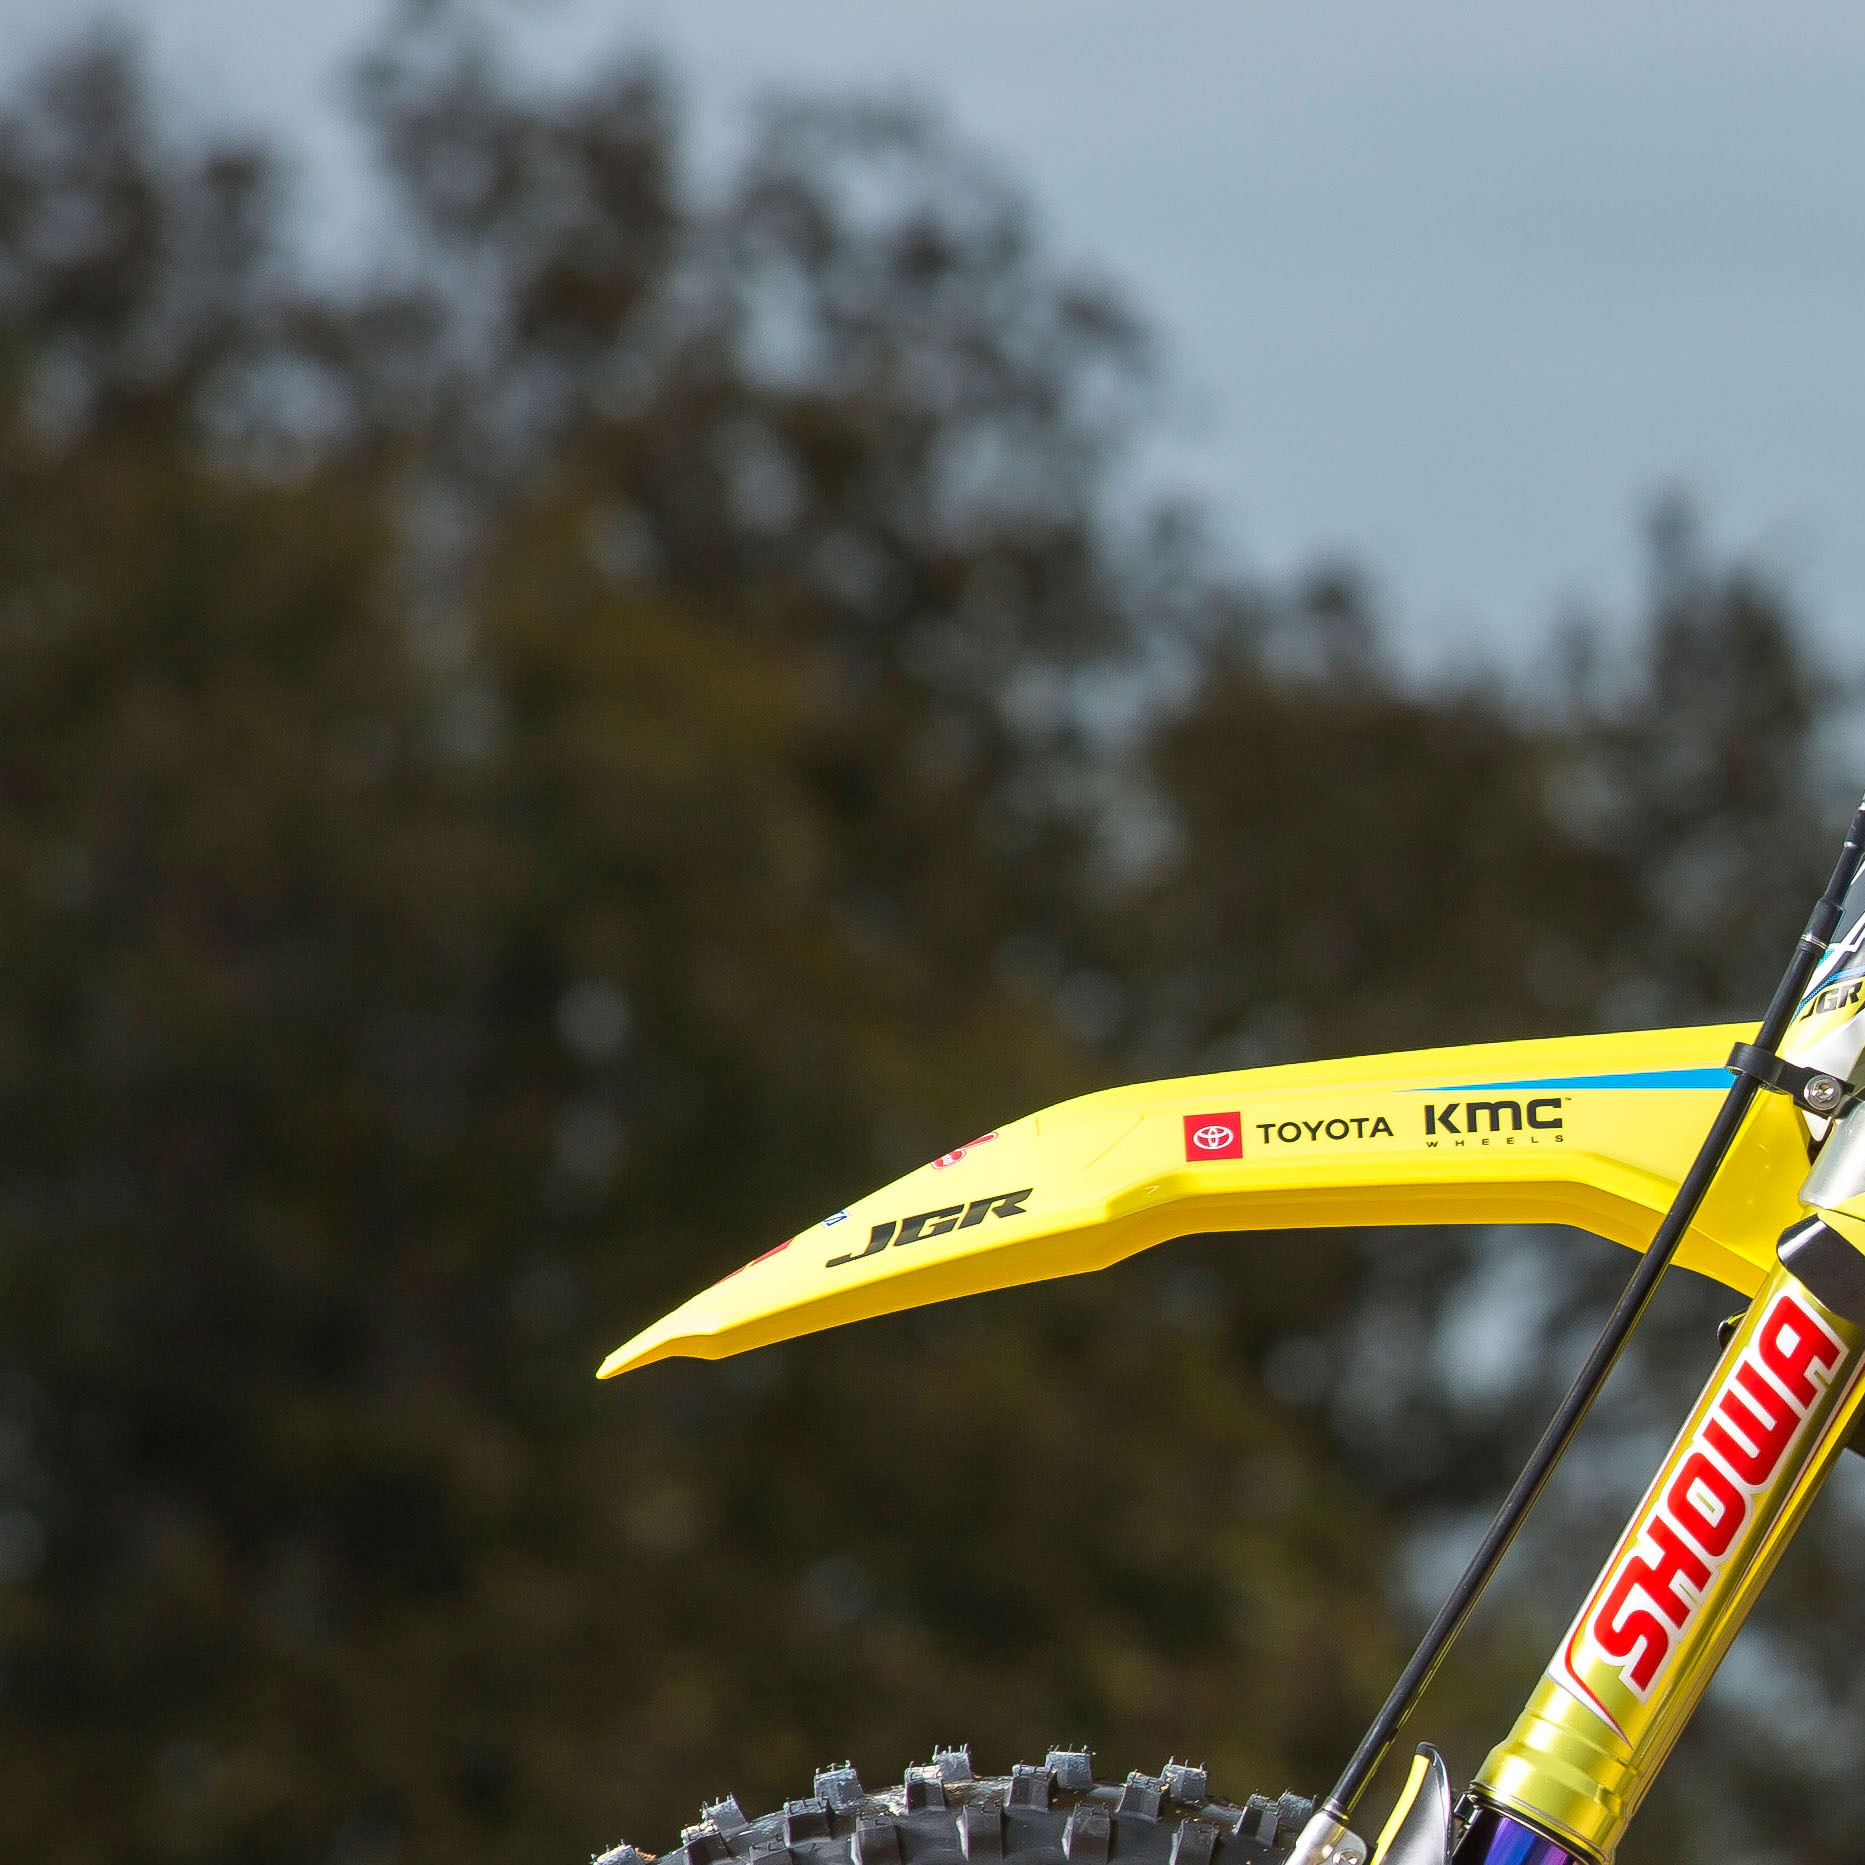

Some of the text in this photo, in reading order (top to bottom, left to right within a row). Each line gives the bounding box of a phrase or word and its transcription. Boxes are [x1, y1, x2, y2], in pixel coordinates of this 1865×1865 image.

[1799, 981, 1864, 1023] JGR
[1257, 1117, 1394, 1145] TOYOTA
[1424, 1098, 1563, 1135] KMC
[1427, 1135, 1563, 1148] WHEELS
[826, 1188, 1034, 1268] JGR
[1593, 1295, 1841, 1693] SHOWA
